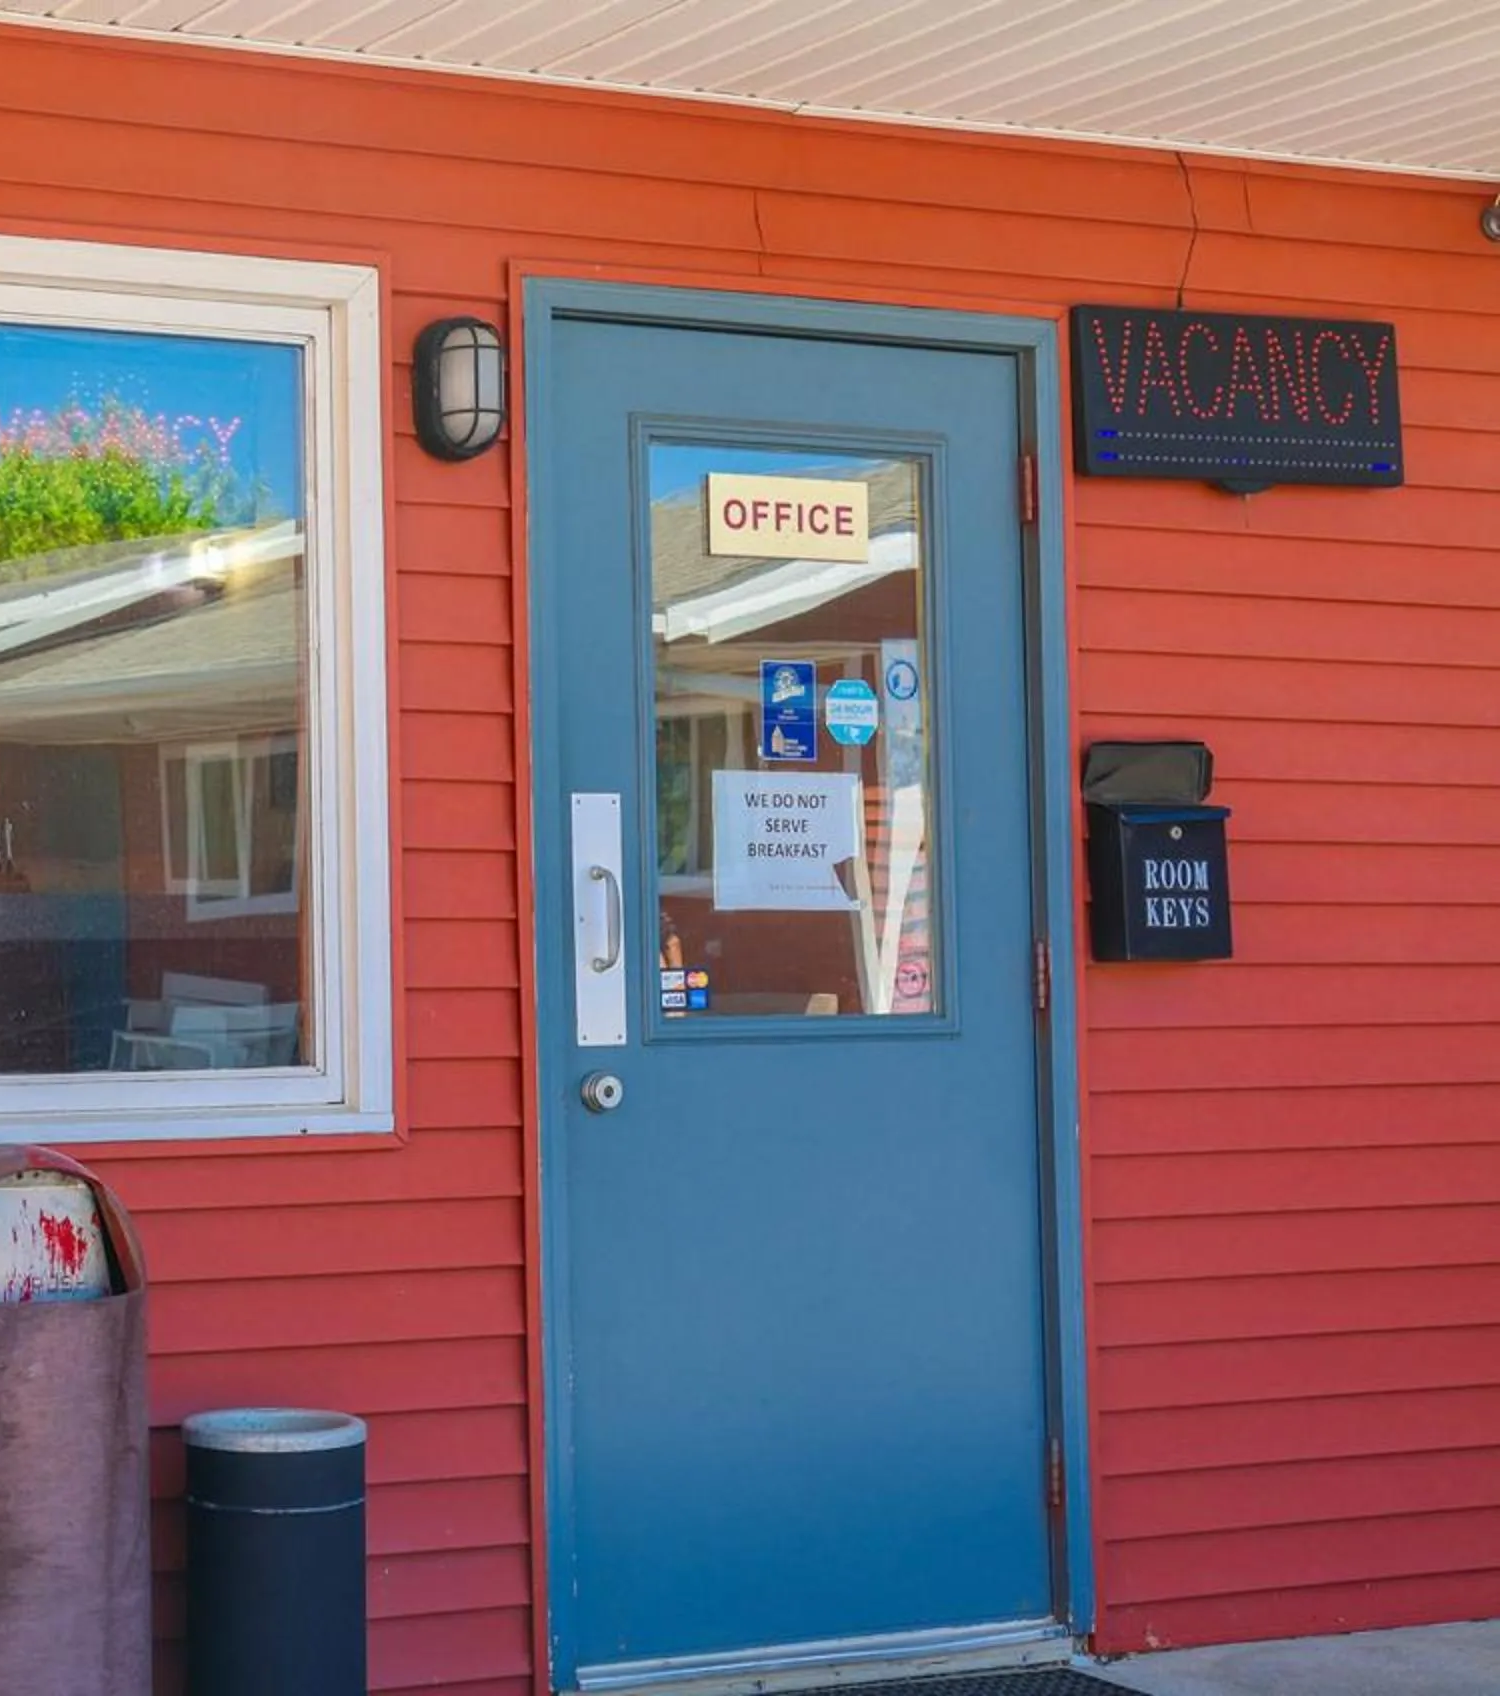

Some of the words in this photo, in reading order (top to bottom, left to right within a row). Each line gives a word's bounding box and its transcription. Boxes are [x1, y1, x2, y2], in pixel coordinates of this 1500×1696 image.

[1093, 318, 1391, 426] VACANCY
[723, 499, 855, 536] OFFICE
[744, 793, 769, 808] WE
[772, 793, 794, 809] DO
[797, 794, 828, 809] NOT
[765, 818, 809, 833] SERVE
[747, 843, 828, 858] BREAKFAST
[1144, 859, 1209, 890] ROOM
[1145, 897, 1209, 927] KEYS
